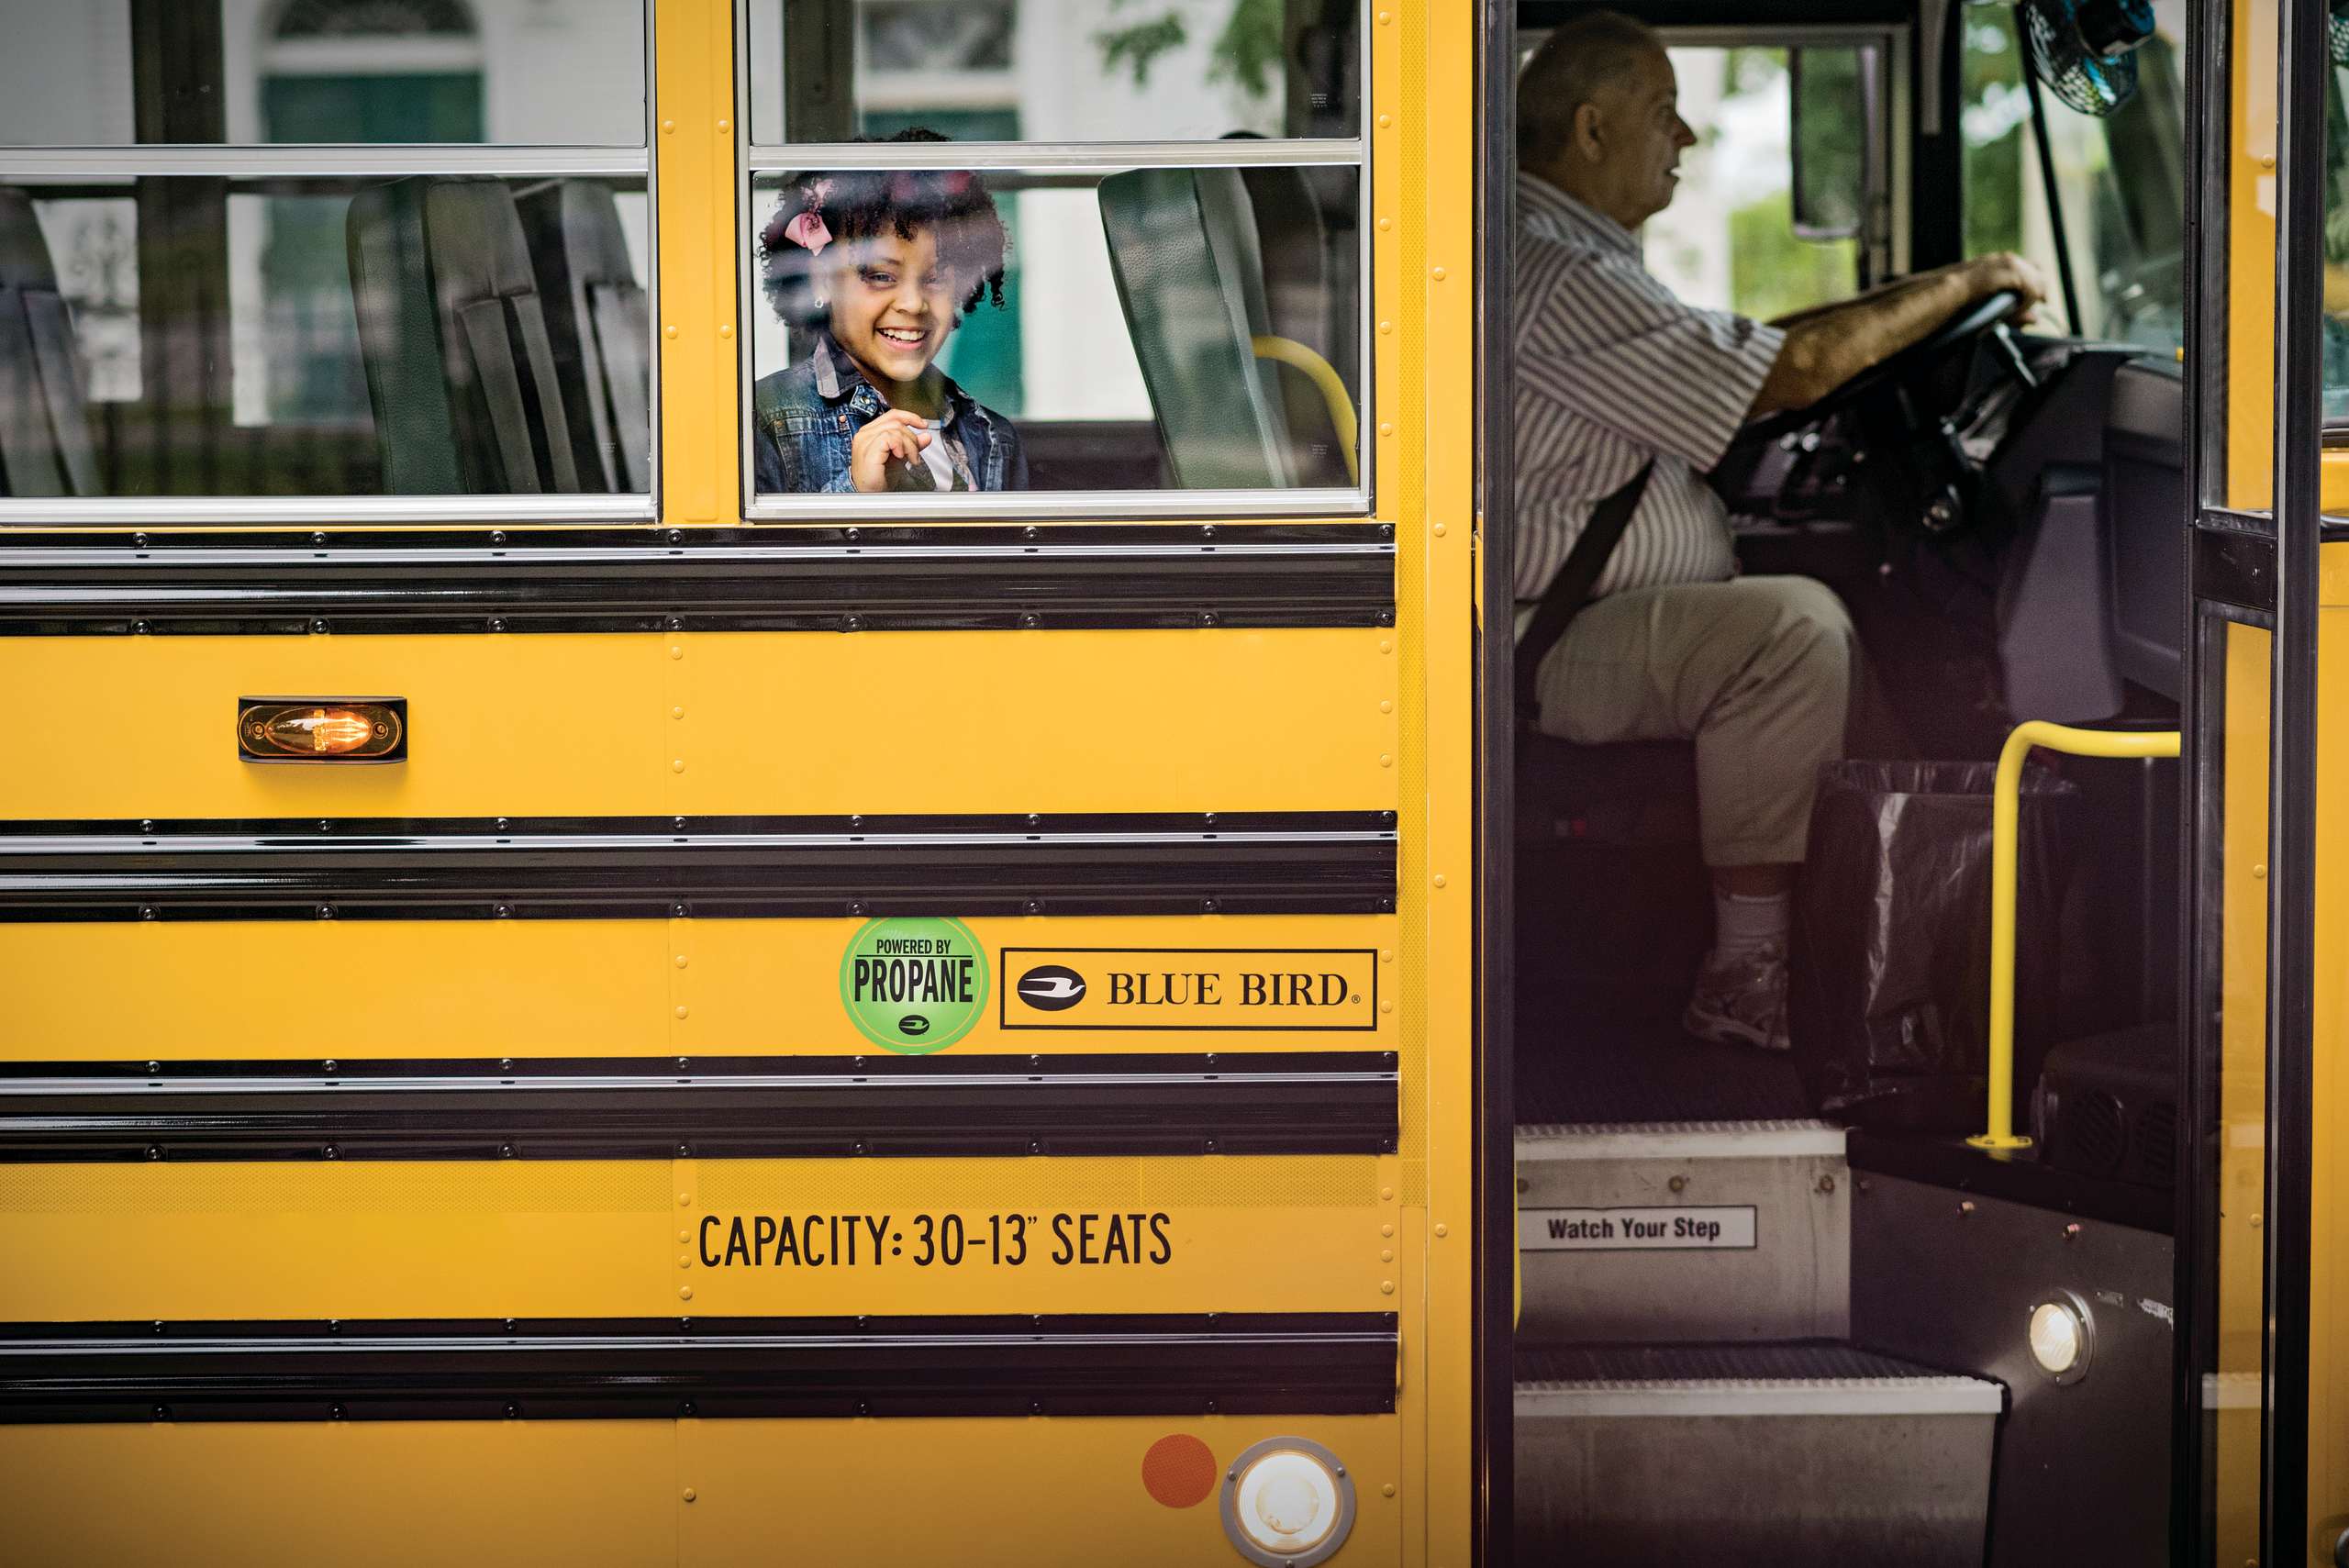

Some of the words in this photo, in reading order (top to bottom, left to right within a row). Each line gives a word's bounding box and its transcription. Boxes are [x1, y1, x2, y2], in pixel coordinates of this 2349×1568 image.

[876, 939, 933, 954] POWERED
[936, 939, 952, 954] BY
[854, 958, 974, 1003] PROPANE
[1107, 973, 1222, 1006] BLUE
[699, 1215, 903, 1268] CAPACITY:
[1052, 1212, 1172, 1265] SEATS
[1548, 1218, 1614, 1240] Watch
[1621, 1218, 1667, 1239] Your
[1674, 1217, 1720, 1241] Step
